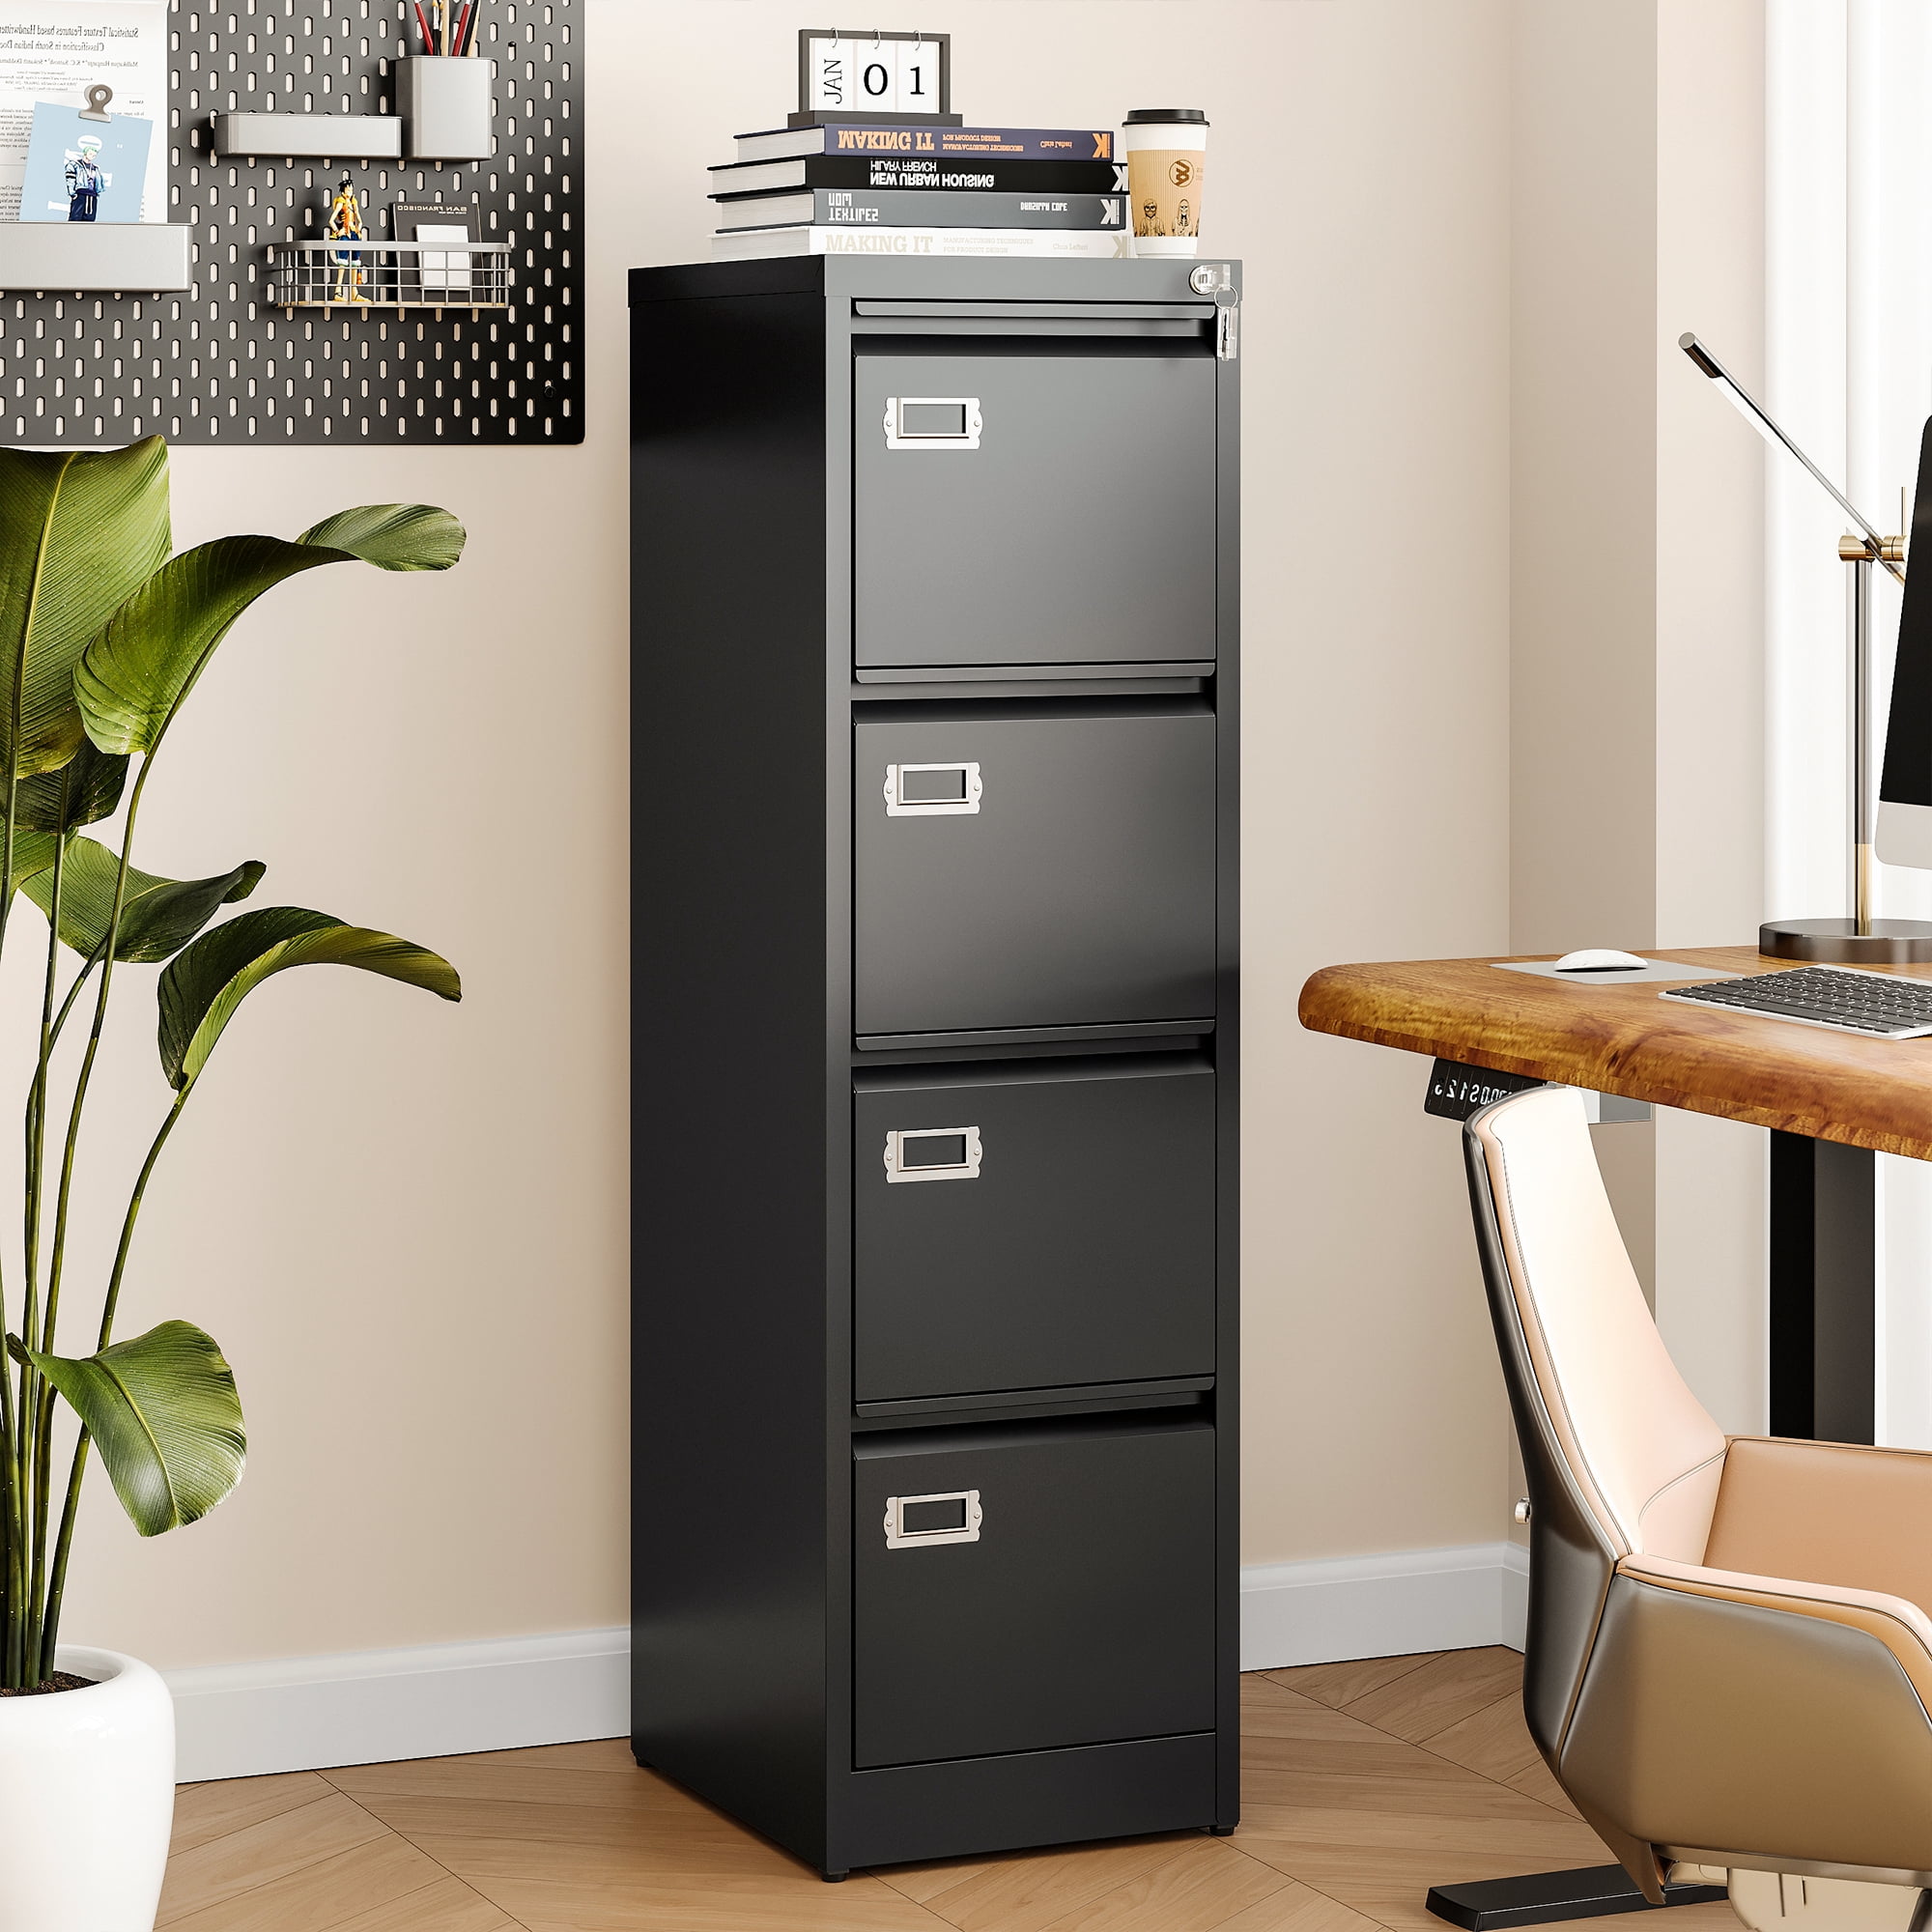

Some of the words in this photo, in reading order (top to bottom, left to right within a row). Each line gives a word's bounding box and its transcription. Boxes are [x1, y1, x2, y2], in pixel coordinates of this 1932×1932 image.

[823, 58, 843, 104] JAN
[825, 234, 907, 253] MAKING
[913, 236, 933, 253] IT
